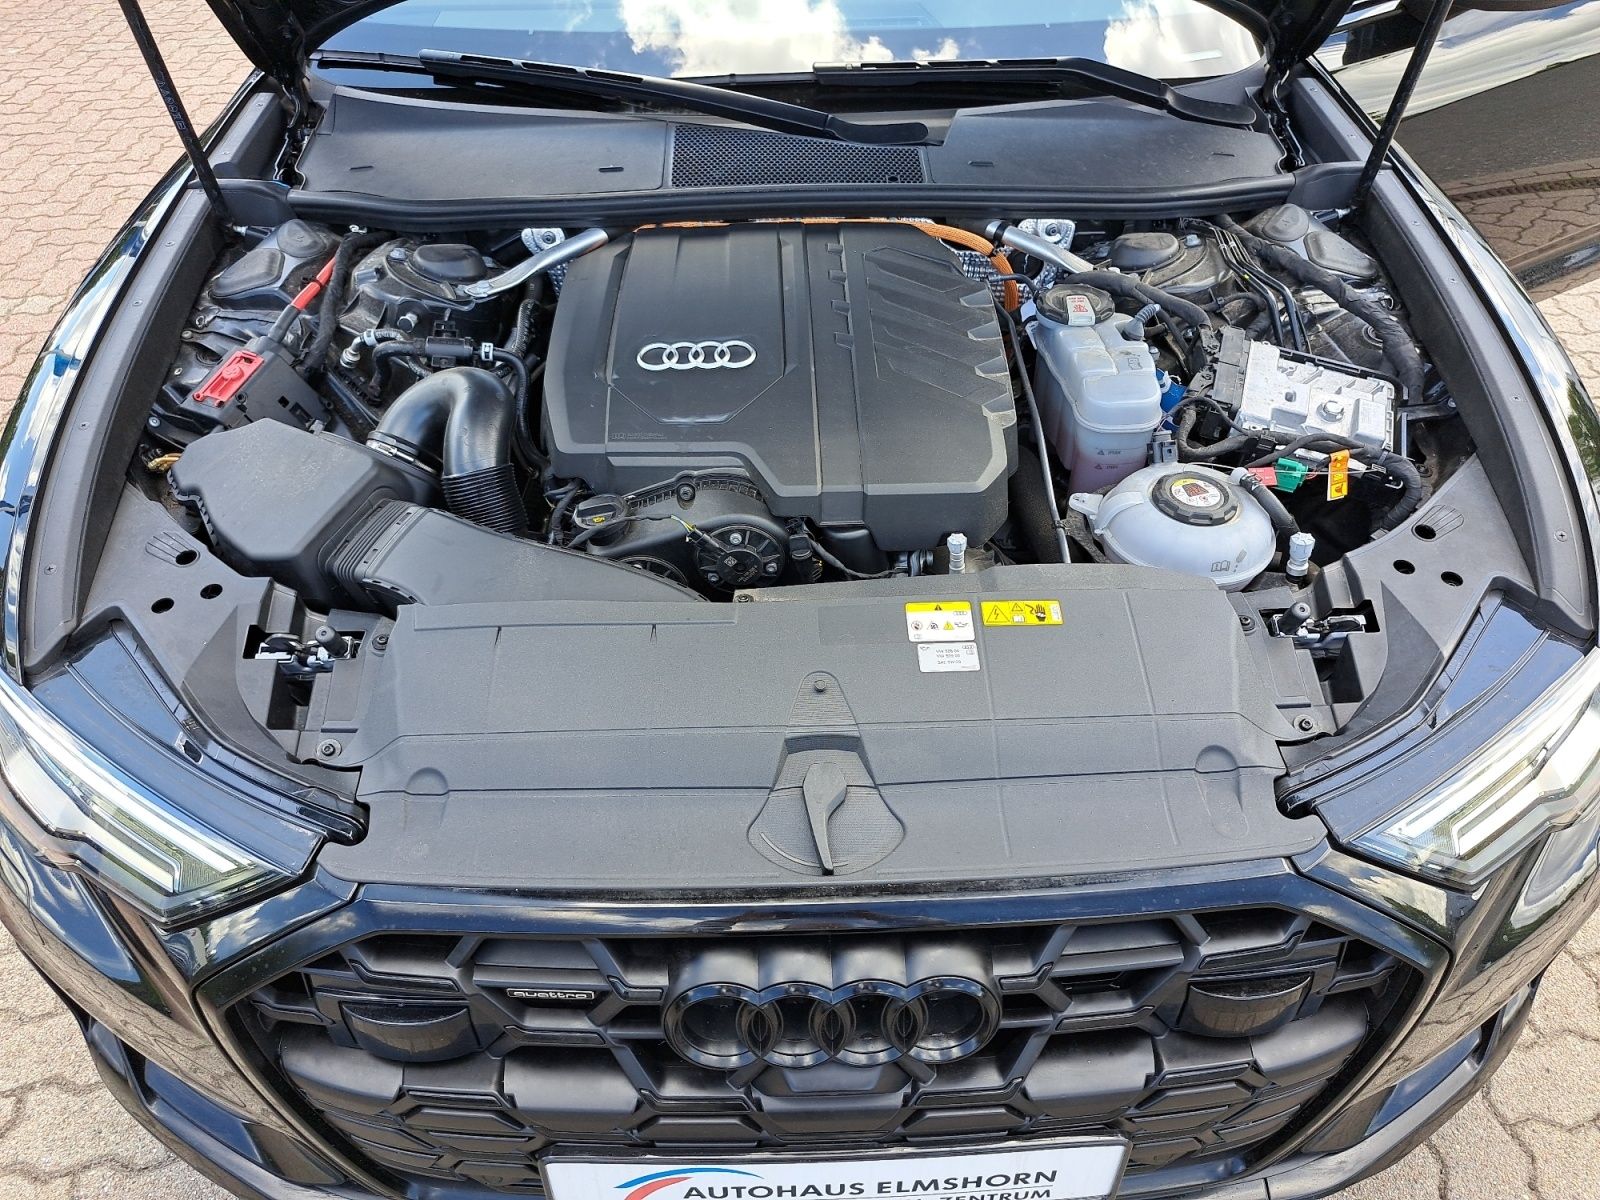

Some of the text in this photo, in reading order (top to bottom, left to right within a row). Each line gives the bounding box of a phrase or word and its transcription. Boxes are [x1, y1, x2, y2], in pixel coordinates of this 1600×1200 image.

[512, 991, 588, 999] quattro
[683, 1170, 1058, 1199] AUTOHAUS ELMSHORN
